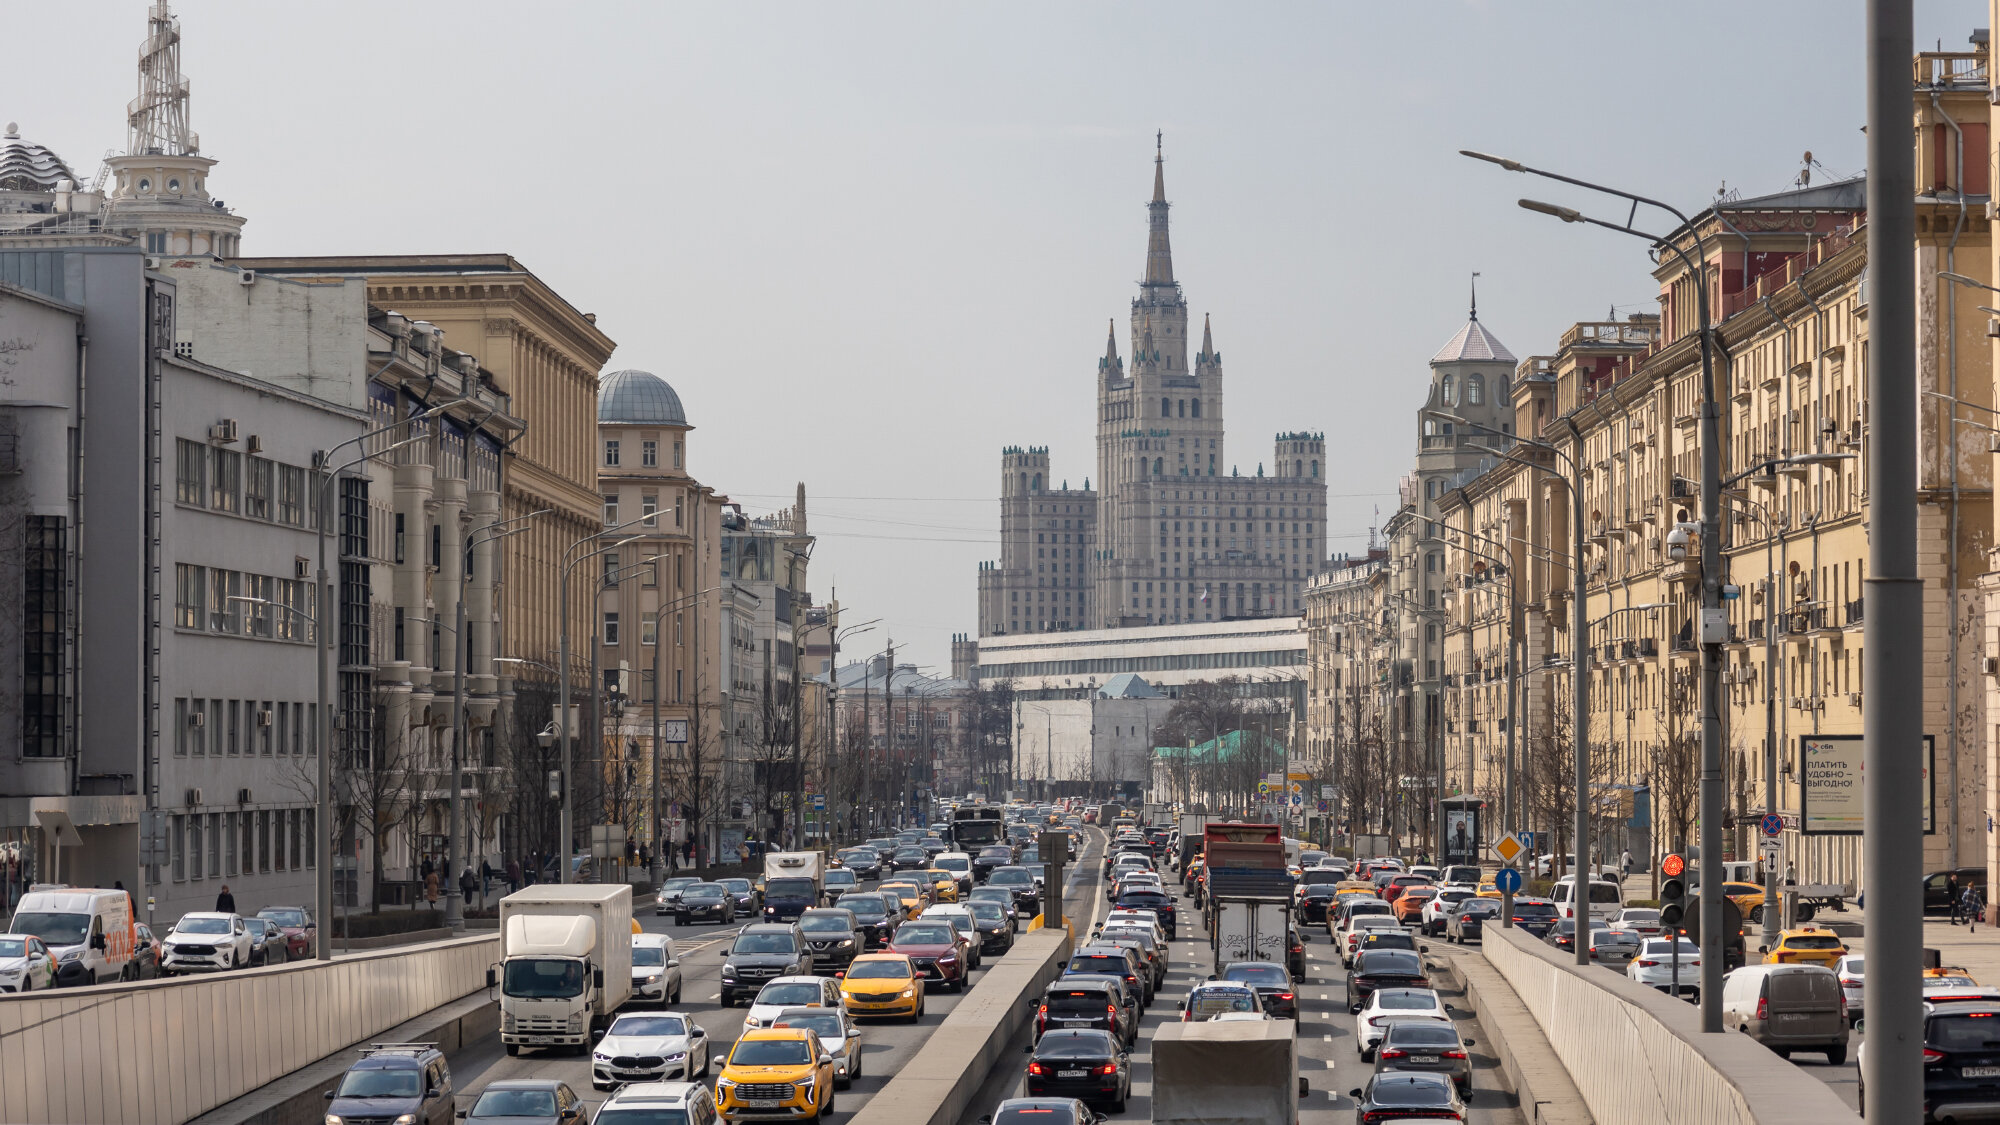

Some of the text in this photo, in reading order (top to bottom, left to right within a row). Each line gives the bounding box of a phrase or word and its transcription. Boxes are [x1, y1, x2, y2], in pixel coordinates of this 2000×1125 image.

[1807, 761, 1848, 769] ПЛАТИТЬ
[1807, 770, 1845, 779] УДОБНО
[1807, 780, 1853, 788] ВЫГОДНО!
